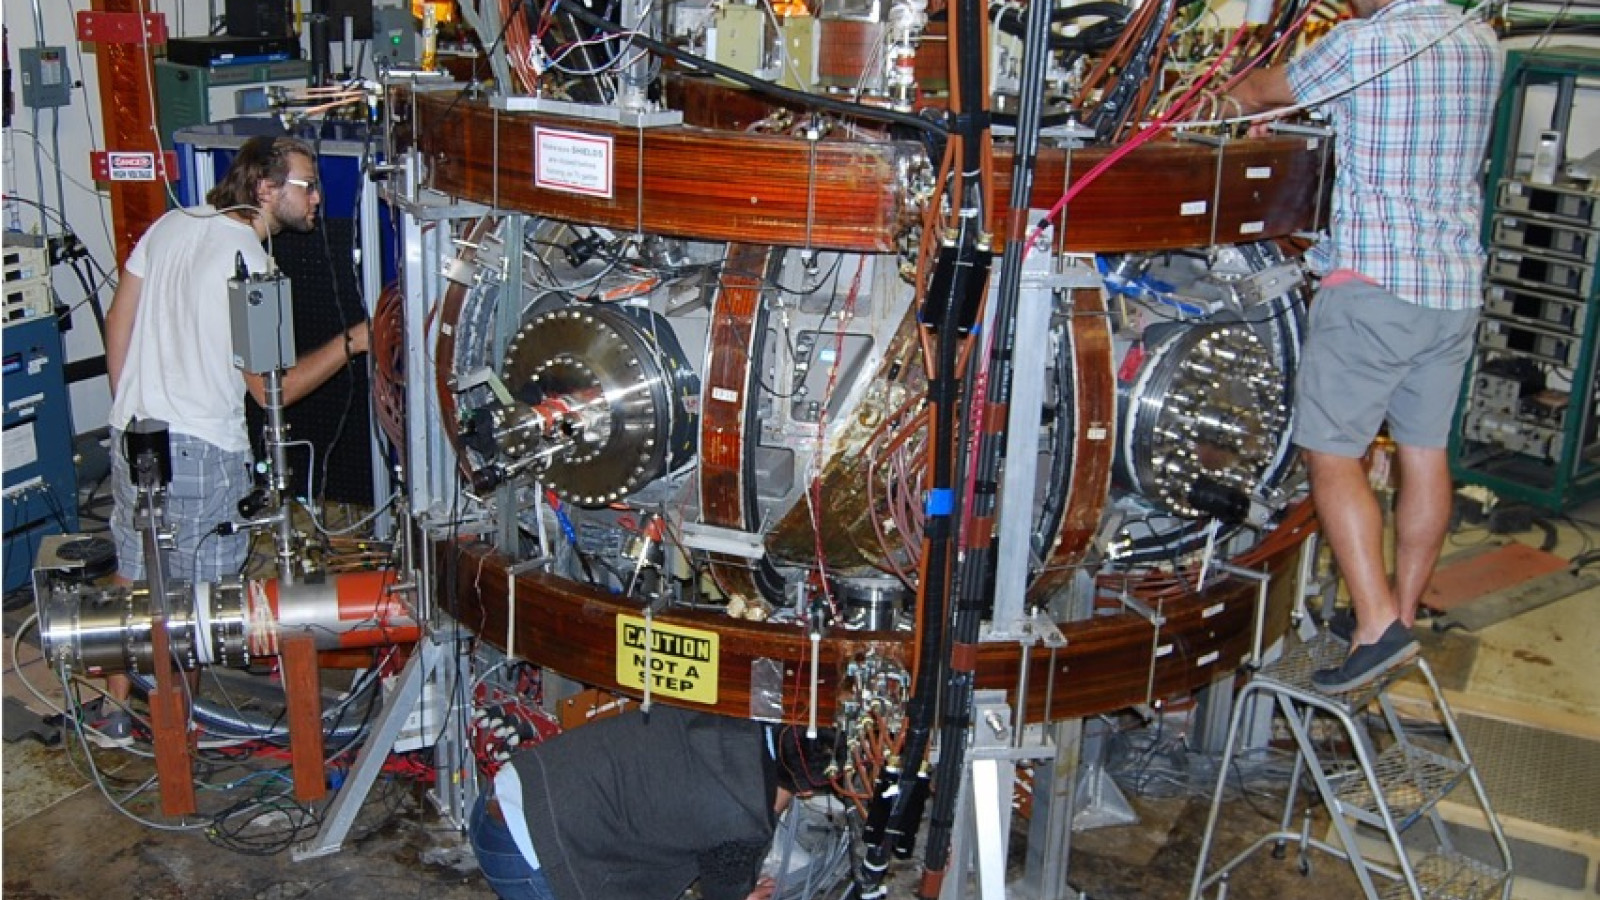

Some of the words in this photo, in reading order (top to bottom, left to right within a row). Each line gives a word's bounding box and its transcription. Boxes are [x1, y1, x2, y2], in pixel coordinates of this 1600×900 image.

[114, 157, 151, 167] DANGER
[113, 170, 127, 179] HIGH
[128, 170, 152, 179] VOLTAGE
[625, 625, 709, 661] CAUTION
[633, 653, 679, 674] NOT
[685, 665, 699, 679] A
[638, 671, 694, 692] STEP
